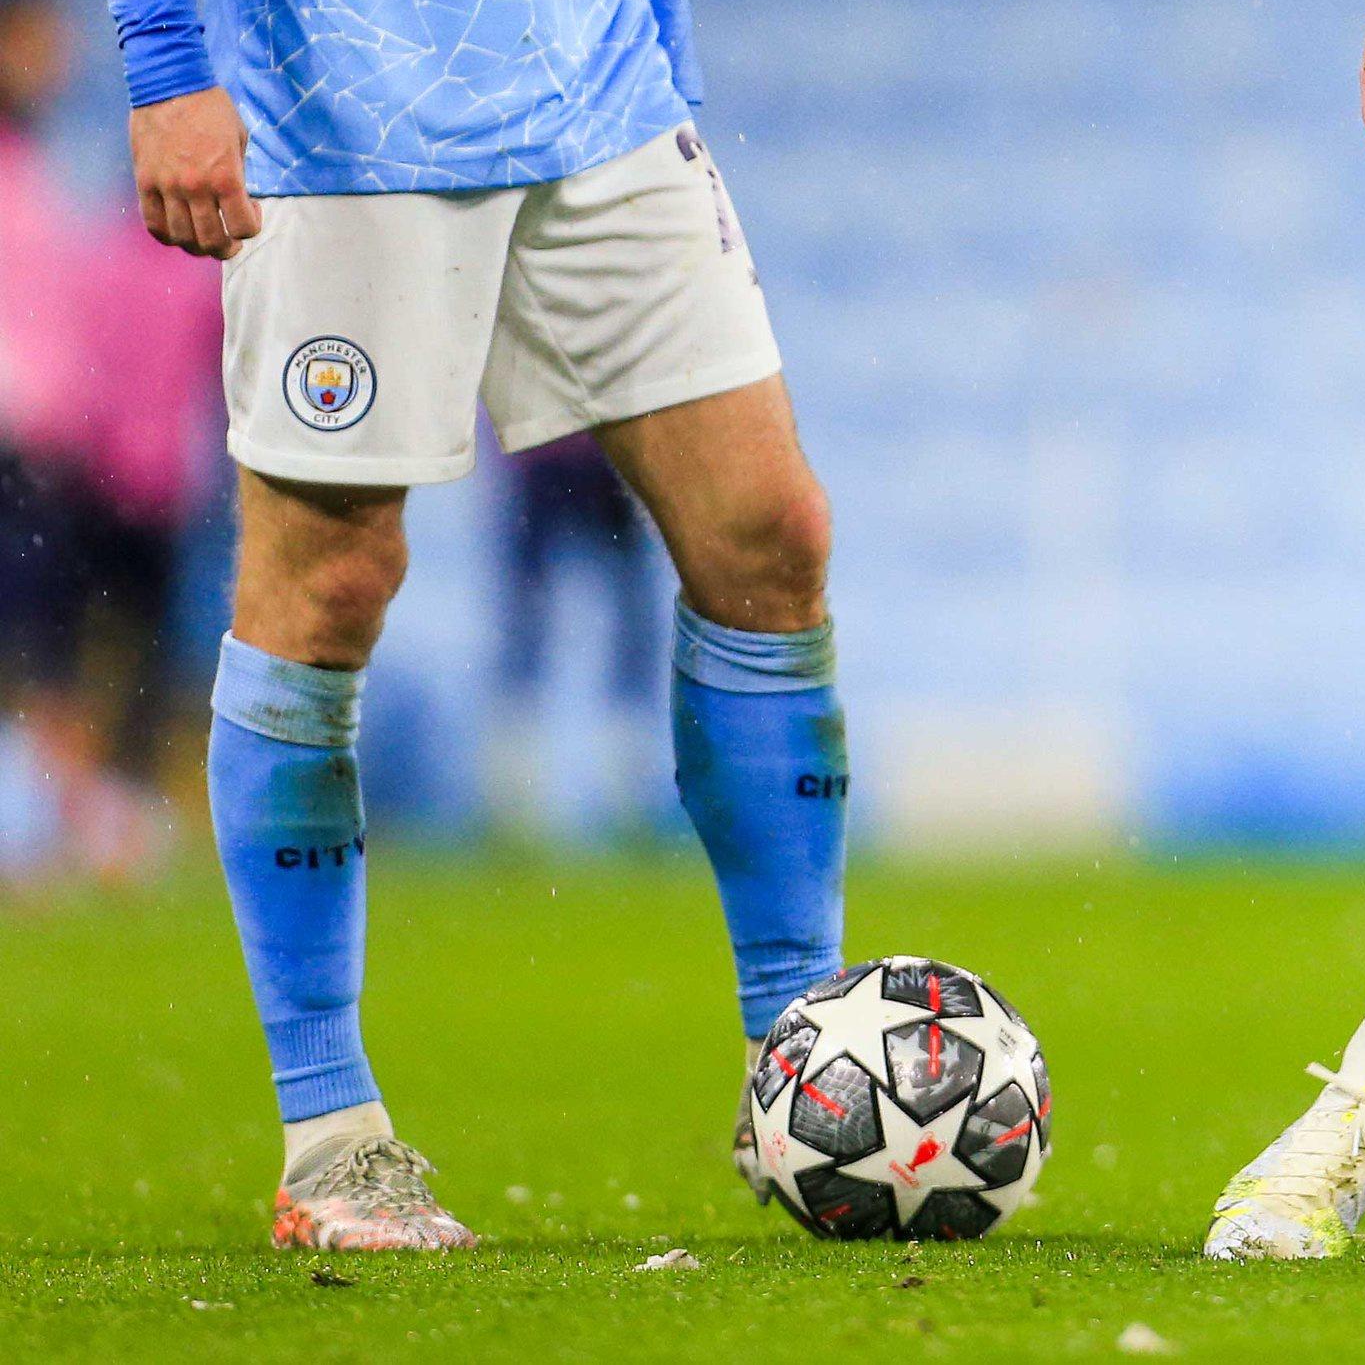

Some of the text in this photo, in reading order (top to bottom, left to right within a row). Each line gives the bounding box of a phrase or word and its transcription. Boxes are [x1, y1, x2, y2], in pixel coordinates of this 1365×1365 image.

[295, 341, 367, 374] MANCHESTER
[313, 414, 341, 425] CITY
[796, 773, 850, 799] CIT
